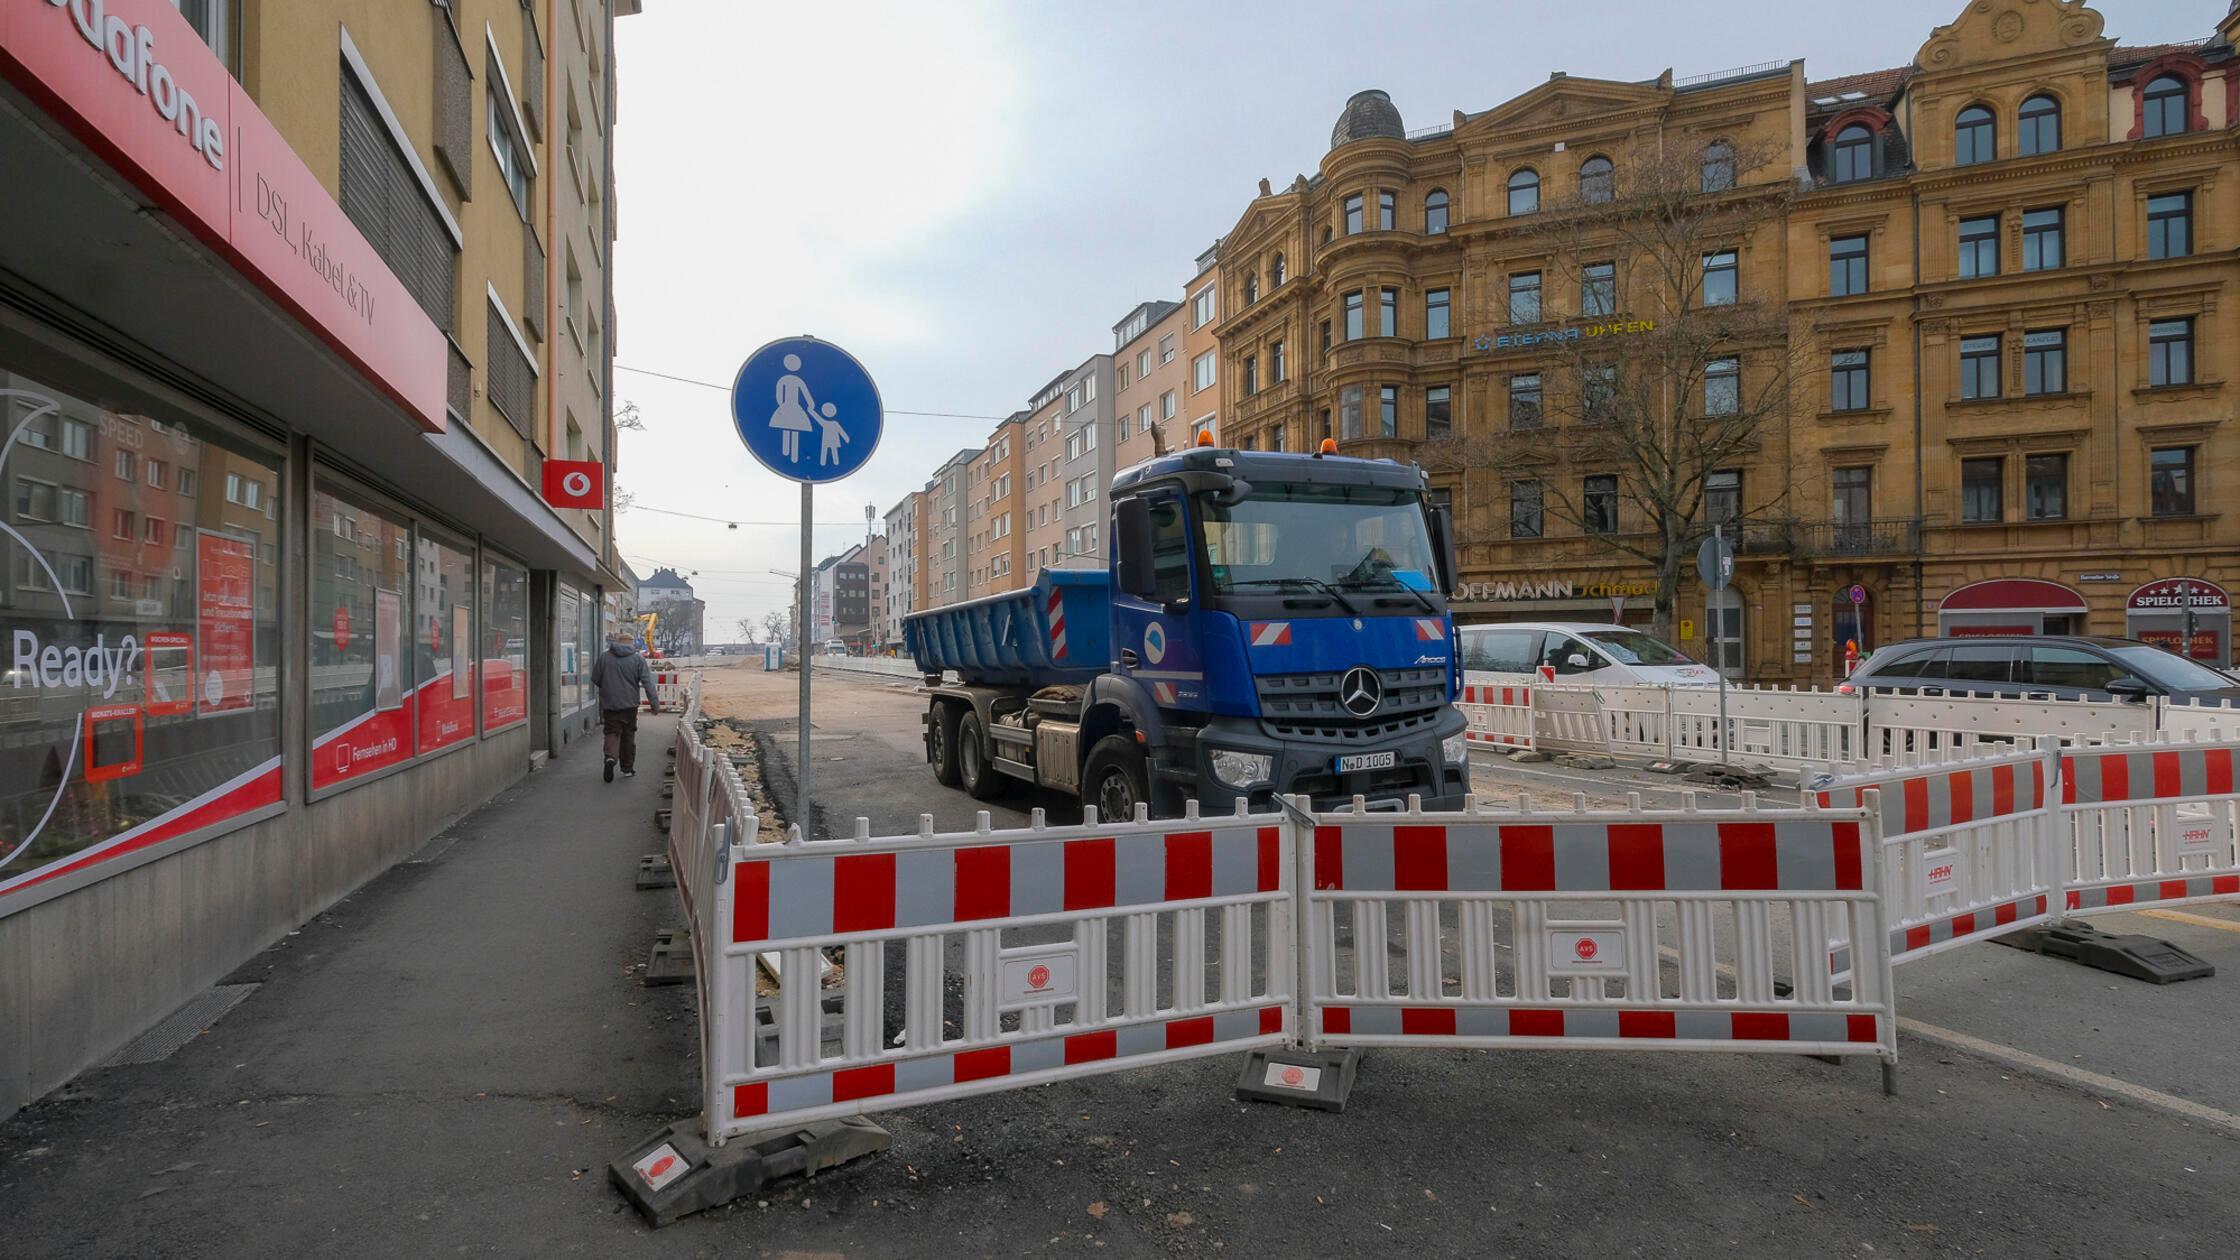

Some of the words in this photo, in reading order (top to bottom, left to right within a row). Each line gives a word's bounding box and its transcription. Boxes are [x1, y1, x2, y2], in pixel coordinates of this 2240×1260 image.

[256, 172, 298, 255] DSL,
[302, 221, 345, 298] Kabel
[347, 272, 357, 311] &
[358, 282, 375, 326] TV
[99, 413, 144, 449] SPEED
[1451, 579, 1573, 601] OFFMANN
[1579, 581, 1659, 598] schmuc
[2136, 595, 2223, 606] SPIELOTHEK
[13, 629, 138, 700] Ready?
[352, 743, 382, 762] Fernsehen
[388, 737, 398, 752] HD
[1342, 758, 1350, 770] N
[1356, 757, 1363, 769] D
[1366, 754, 1391, 768] 1005
